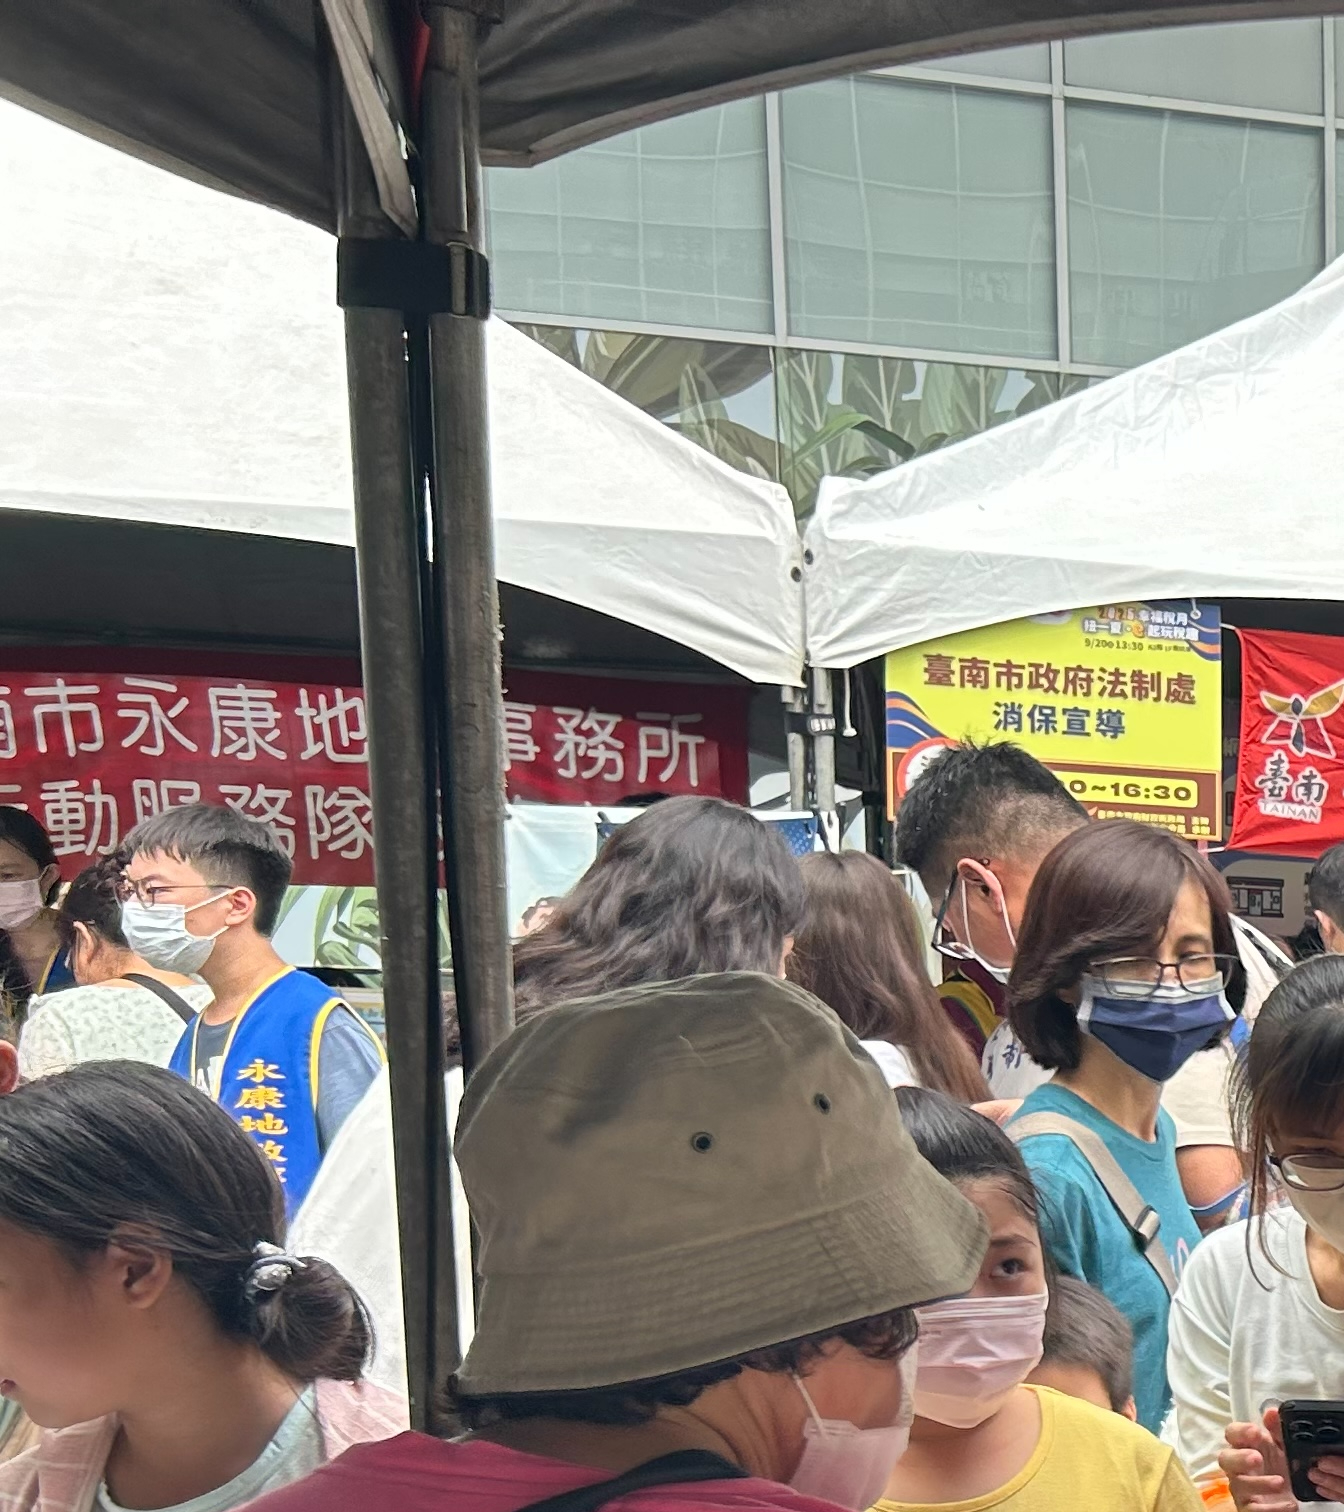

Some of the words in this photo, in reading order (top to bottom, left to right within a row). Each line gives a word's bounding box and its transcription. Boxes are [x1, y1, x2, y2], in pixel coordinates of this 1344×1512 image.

[924, 654, 1196, 705] 臺南市政府法制處
[993, 702, 1126, 739] 消保宣導
[1257, 752, 1327, 804] 臺南
[1262, 802, 1319, 820] TAINAN
